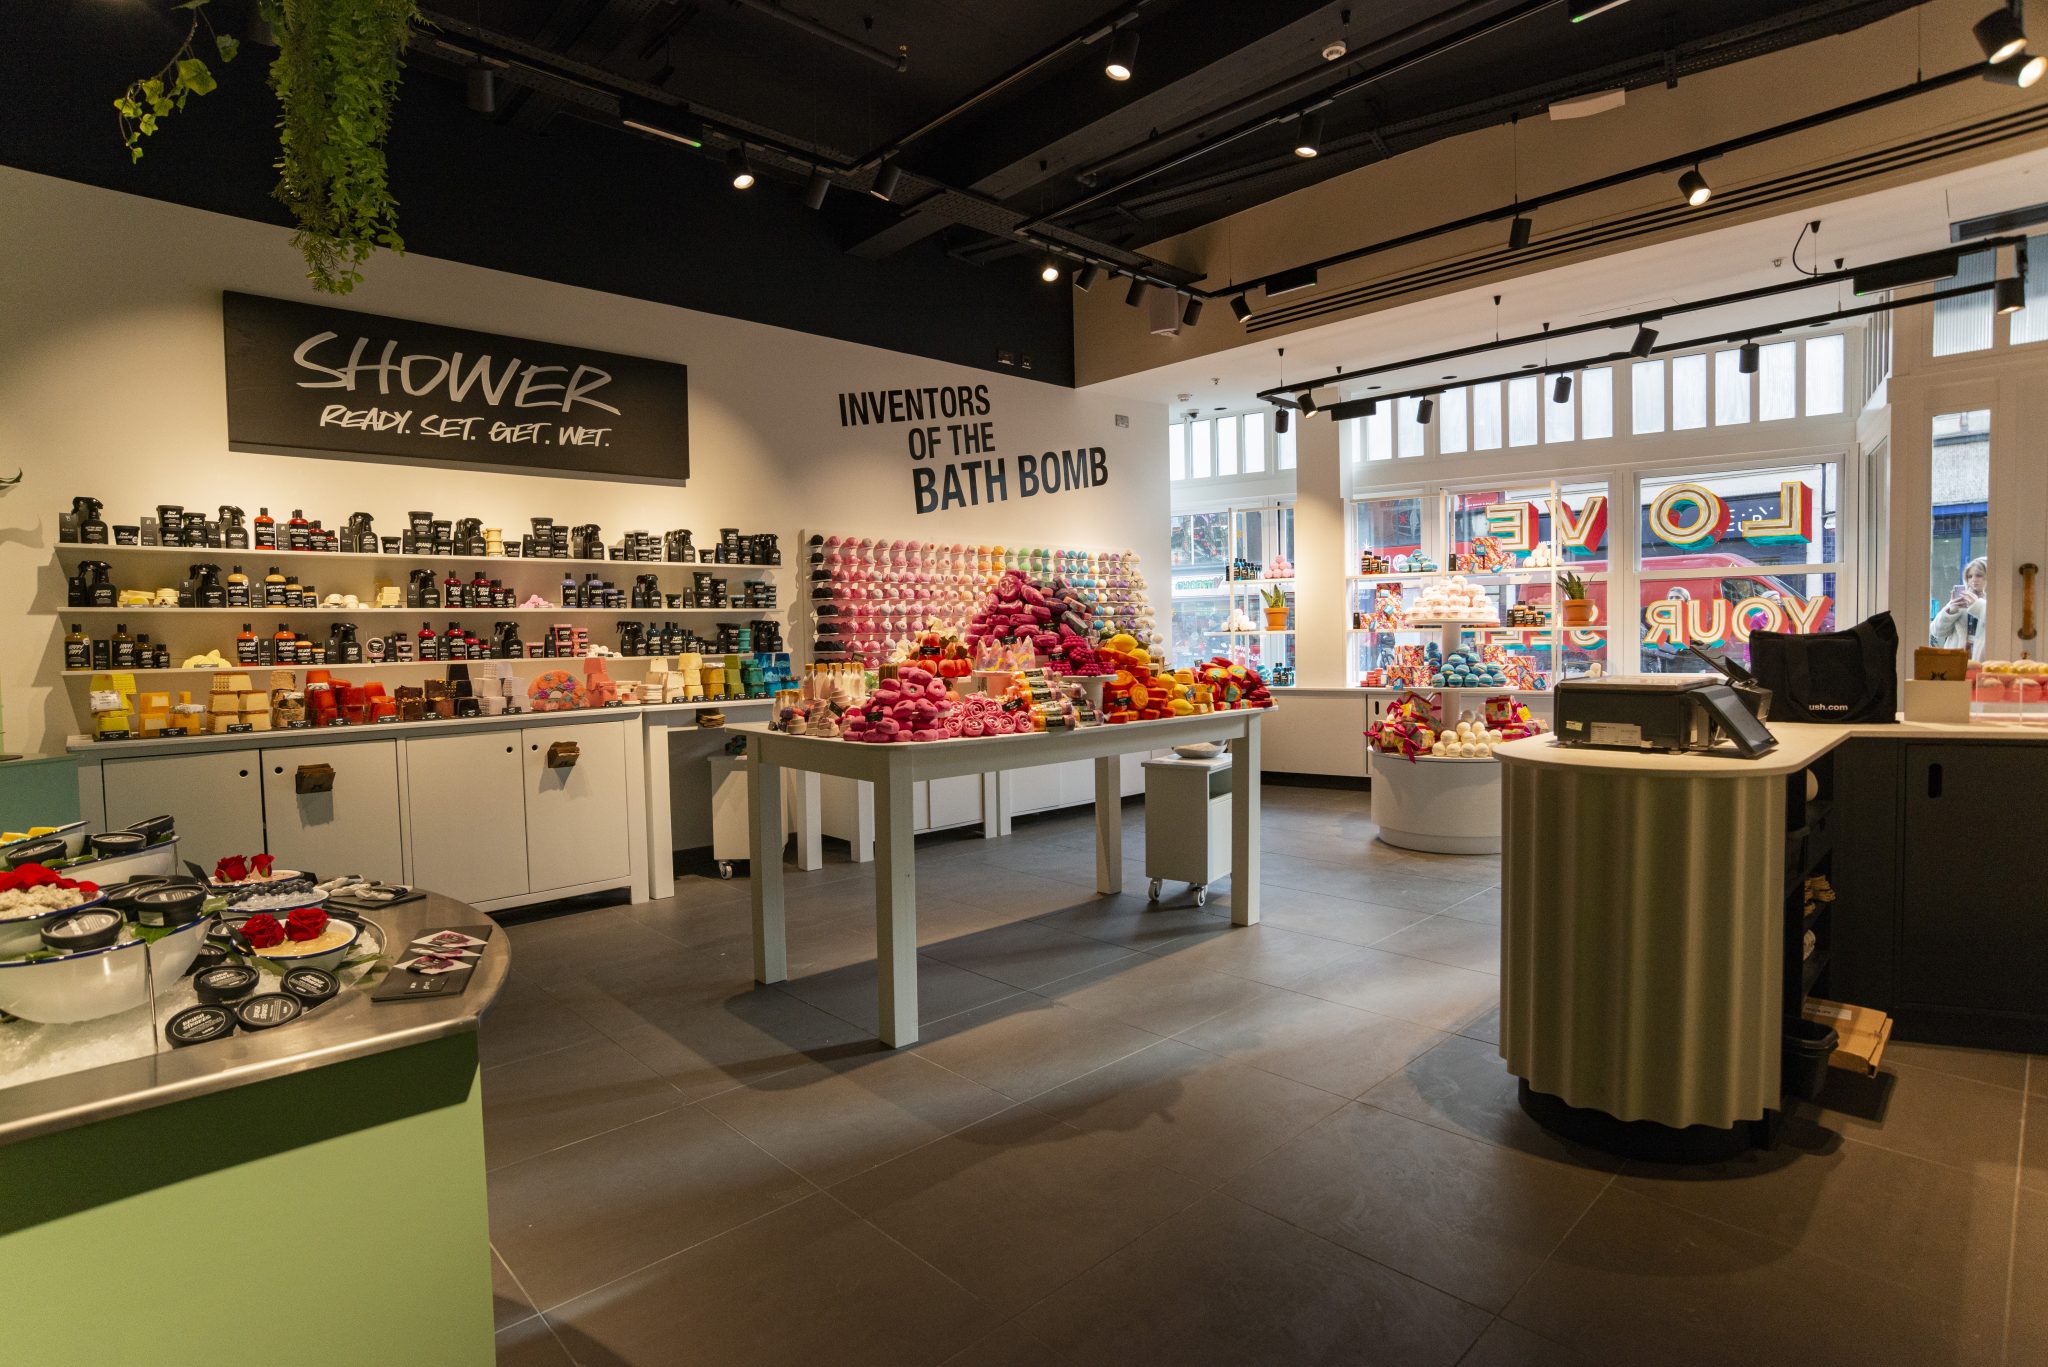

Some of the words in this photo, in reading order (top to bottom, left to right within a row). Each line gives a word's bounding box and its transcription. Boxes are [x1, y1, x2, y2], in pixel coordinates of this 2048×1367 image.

[293, 331, 621, 415] SHOWER
[319, 405, 411, 434] READY.
[420, 414, 484, 440] SET.
[489, 421, 551, 445] GET.
[558, 426, 610, 447] WET.
[839, 384, 991, 427] INVENTORS
[908, 426, 941, 461] OF
[947, 421, 996, 456] THE
[912, 458, 1008, 515] BATH
[1018, 446, 1109, 498] BOMB
